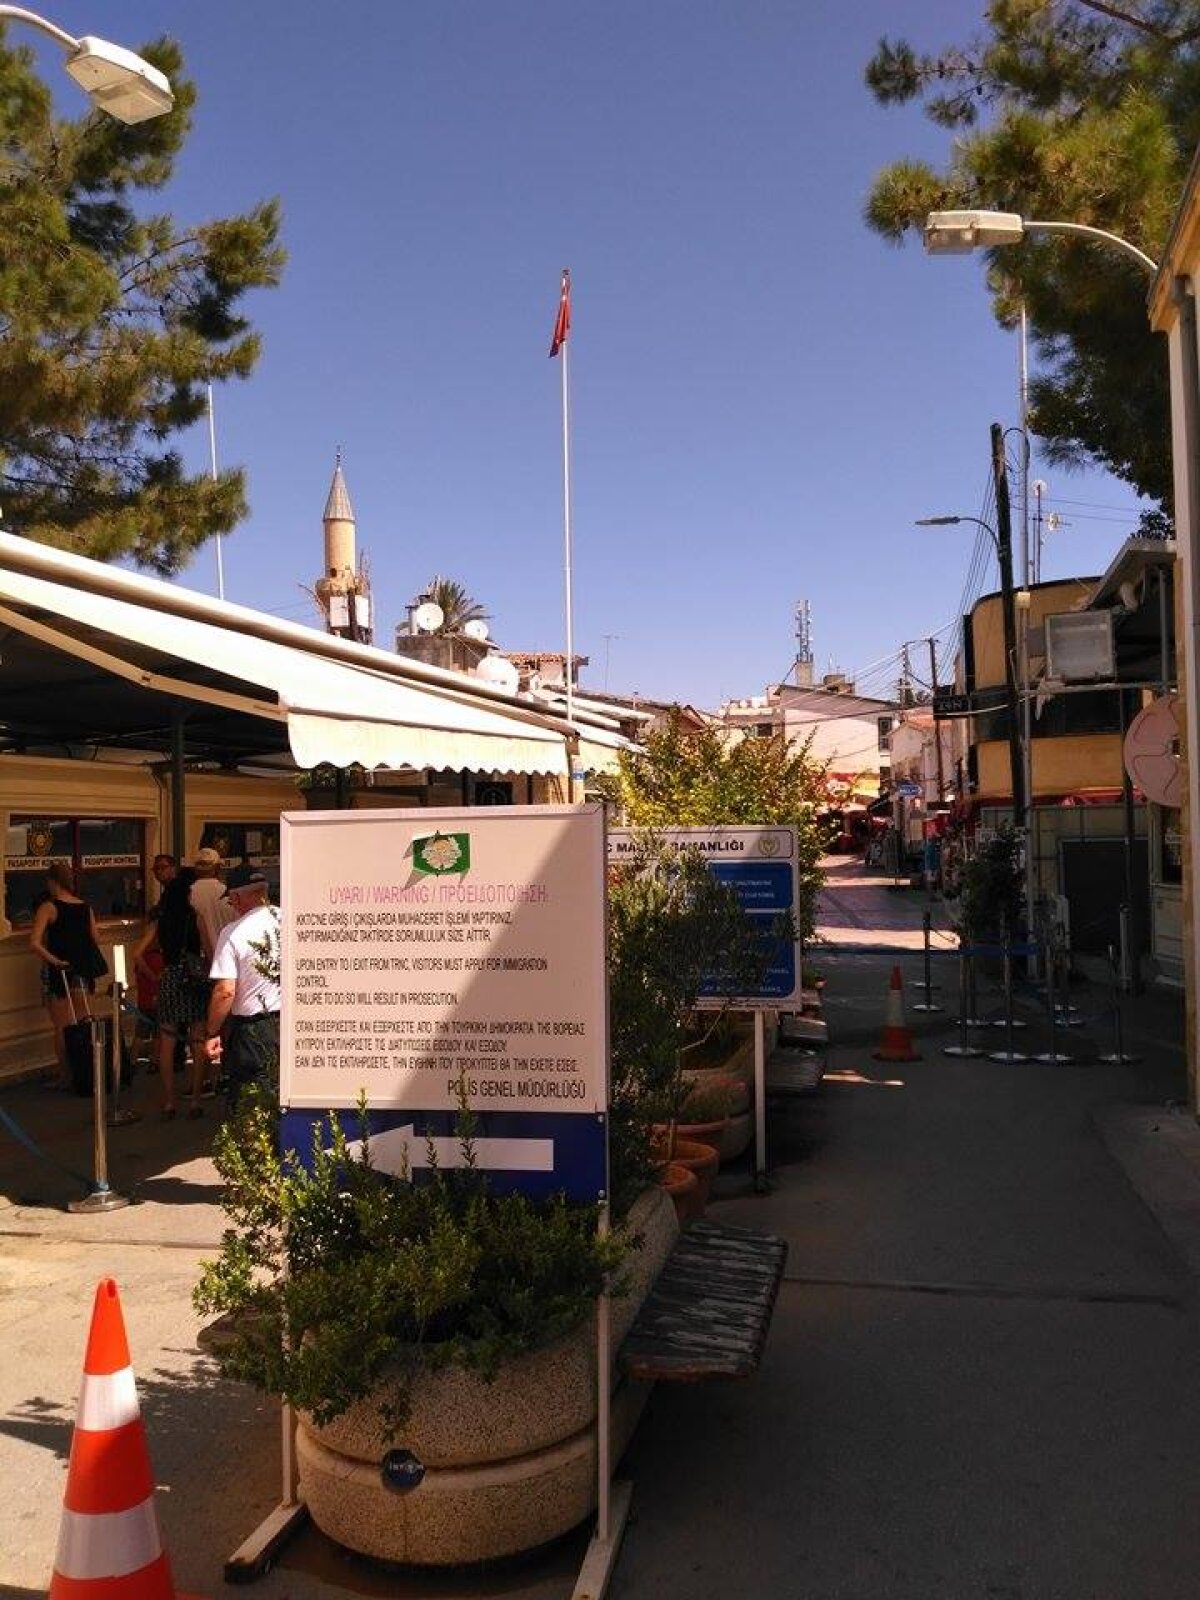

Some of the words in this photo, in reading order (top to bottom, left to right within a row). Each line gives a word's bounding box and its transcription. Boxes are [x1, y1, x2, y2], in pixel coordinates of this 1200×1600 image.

[329, 886, 363, 904] UYARI
[373, 885, 429, 903] WARNING
[396, 929, 445, 942] SORUMLULUK
[448, 928, 463, 942] SİZE
[296, 958, 315, 971] UPON
[317, 958, 337, 971] ENTRY
[339, 958, 349, 971] TO
[354, 958, 368, 971] EXIT
[370, 958, 389, 971] FROM
[412, 958, 443, 971] VISITORS
[444, 958, 463, 971] MUST
[465, 958, 485, 971] APPLY
[486, 958, 500, 971] FOR
[502, 958, 548, 971] IMMIGRATION
[296, 992, 322, 1005] FAILURE
[324, 992, 333, 1005] TO
[334, 992, 344, 1005] DO
[346, 992, 355, 1005] SO
[357, 992, 372, 1005] WILL
[374, 992, 399, 1005] RESULT
[400, 992, 407, 1005] IN
[480, 1079, 515, 1098] GENEL
[518, 1078, 585, 1099] MÜDÜRLÜĞÜ
